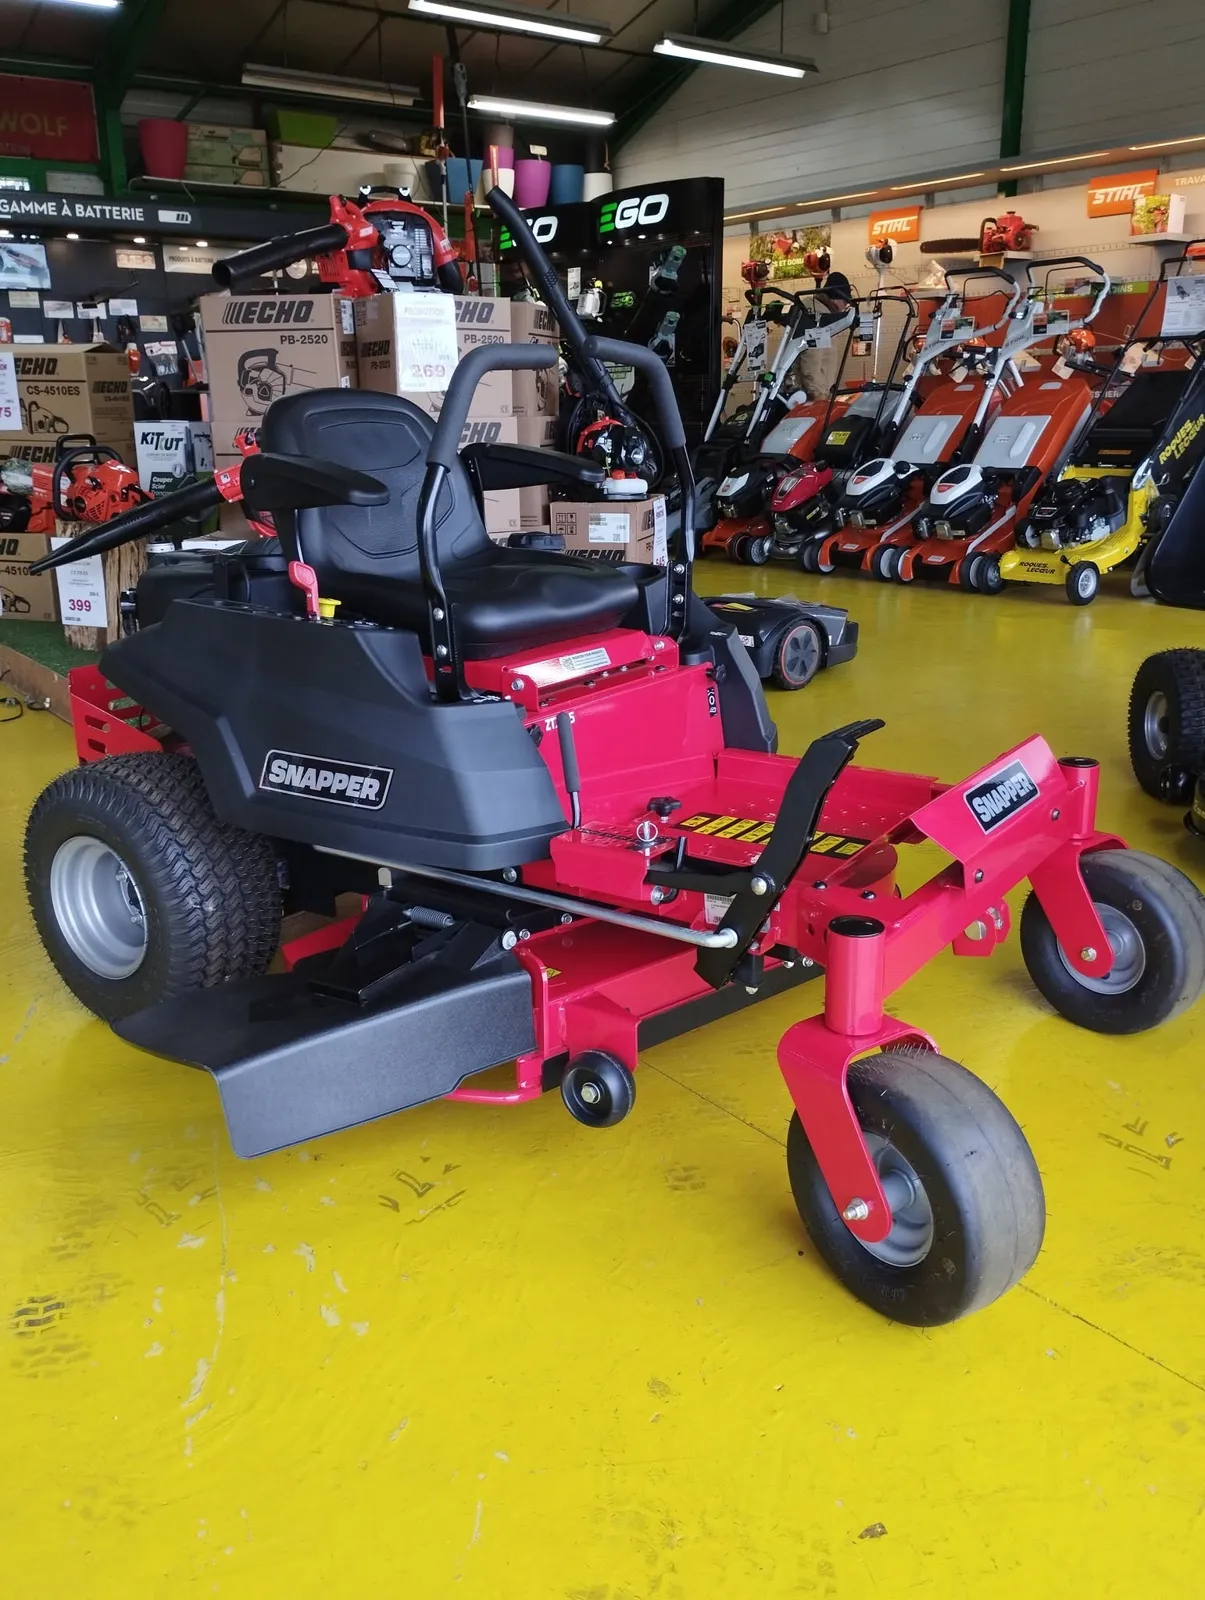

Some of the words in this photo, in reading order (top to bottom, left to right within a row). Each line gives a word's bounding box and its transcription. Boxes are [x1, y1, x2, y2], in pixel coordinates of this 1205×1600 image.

[1088, 182, 1154, 205] STIHL
[0, 199, 57, 215] GAMME
[62, 199, 71, 216] À
[75, 203, 144, 221] BATTERIE
[600, 193, 669, 233] EGO
[872, 215, 918, 235] STIHL
[241, 300, 314, 324] ECHO
[280, 335, 328, 345] PB-2520
[463, 334, 504, 345] PB-2520
[27, 386, 80, 396] CS-4510ES
[68, 599, 92, 612] 399
[268, 759, 380, 801] SNAPPER
[972, 772, 1034, 823] SNAPPER
